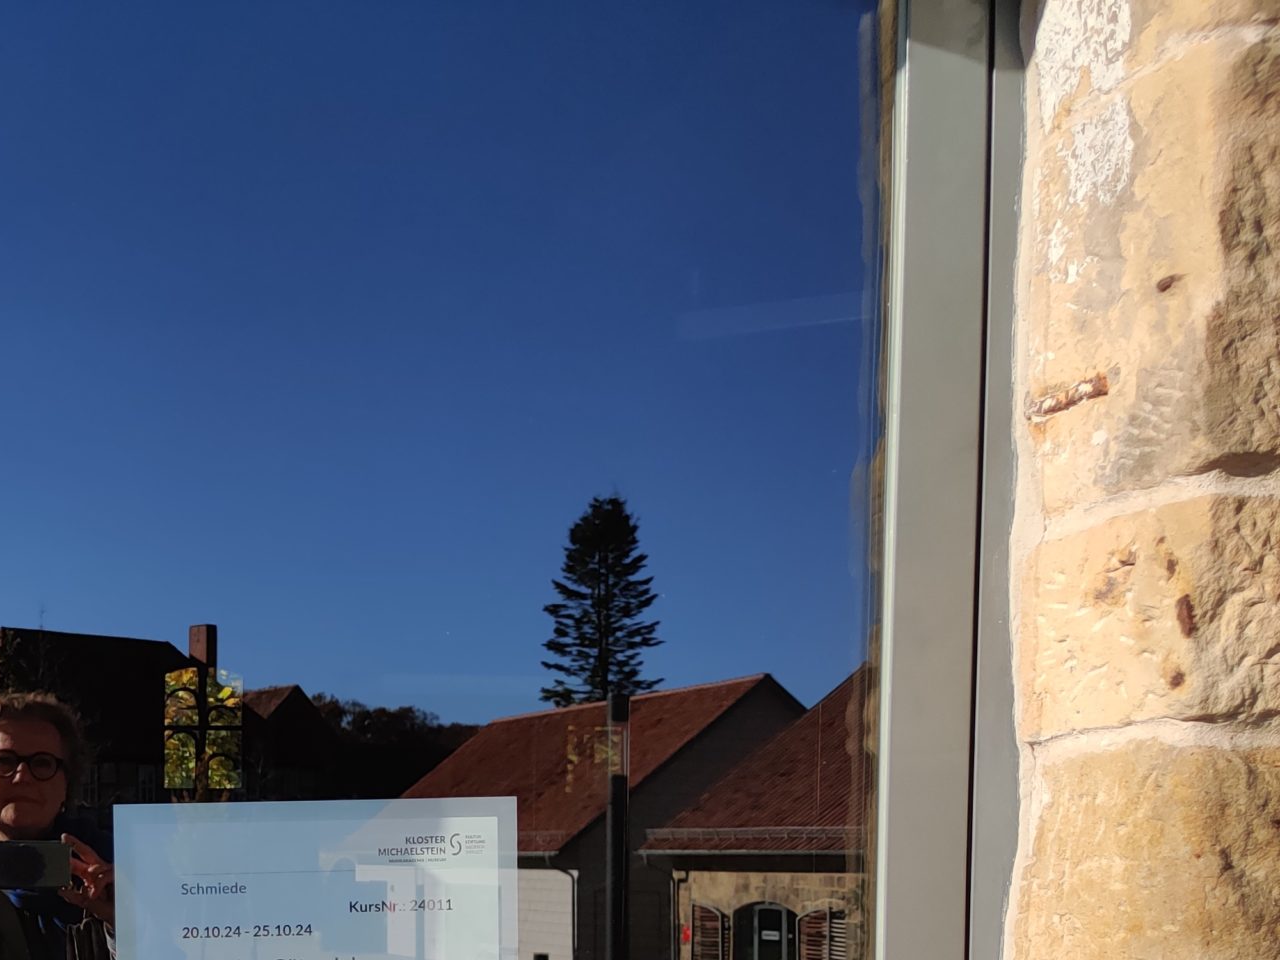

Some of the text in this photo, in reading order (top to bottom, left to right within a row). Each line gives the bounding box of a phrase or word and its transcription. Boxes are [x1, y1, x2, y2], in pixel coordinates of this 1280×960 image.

[405, 835, 446, 845] KLOSTER
[378, 847, 446, 856] MICHAELSTEIN
[181, 883, 247, 895] Schmiede
[409, 899, 453, 912] 24011
[182, 926, 242, 939] 20.10.24
[253, 924, 313, 937] 25.10.24
